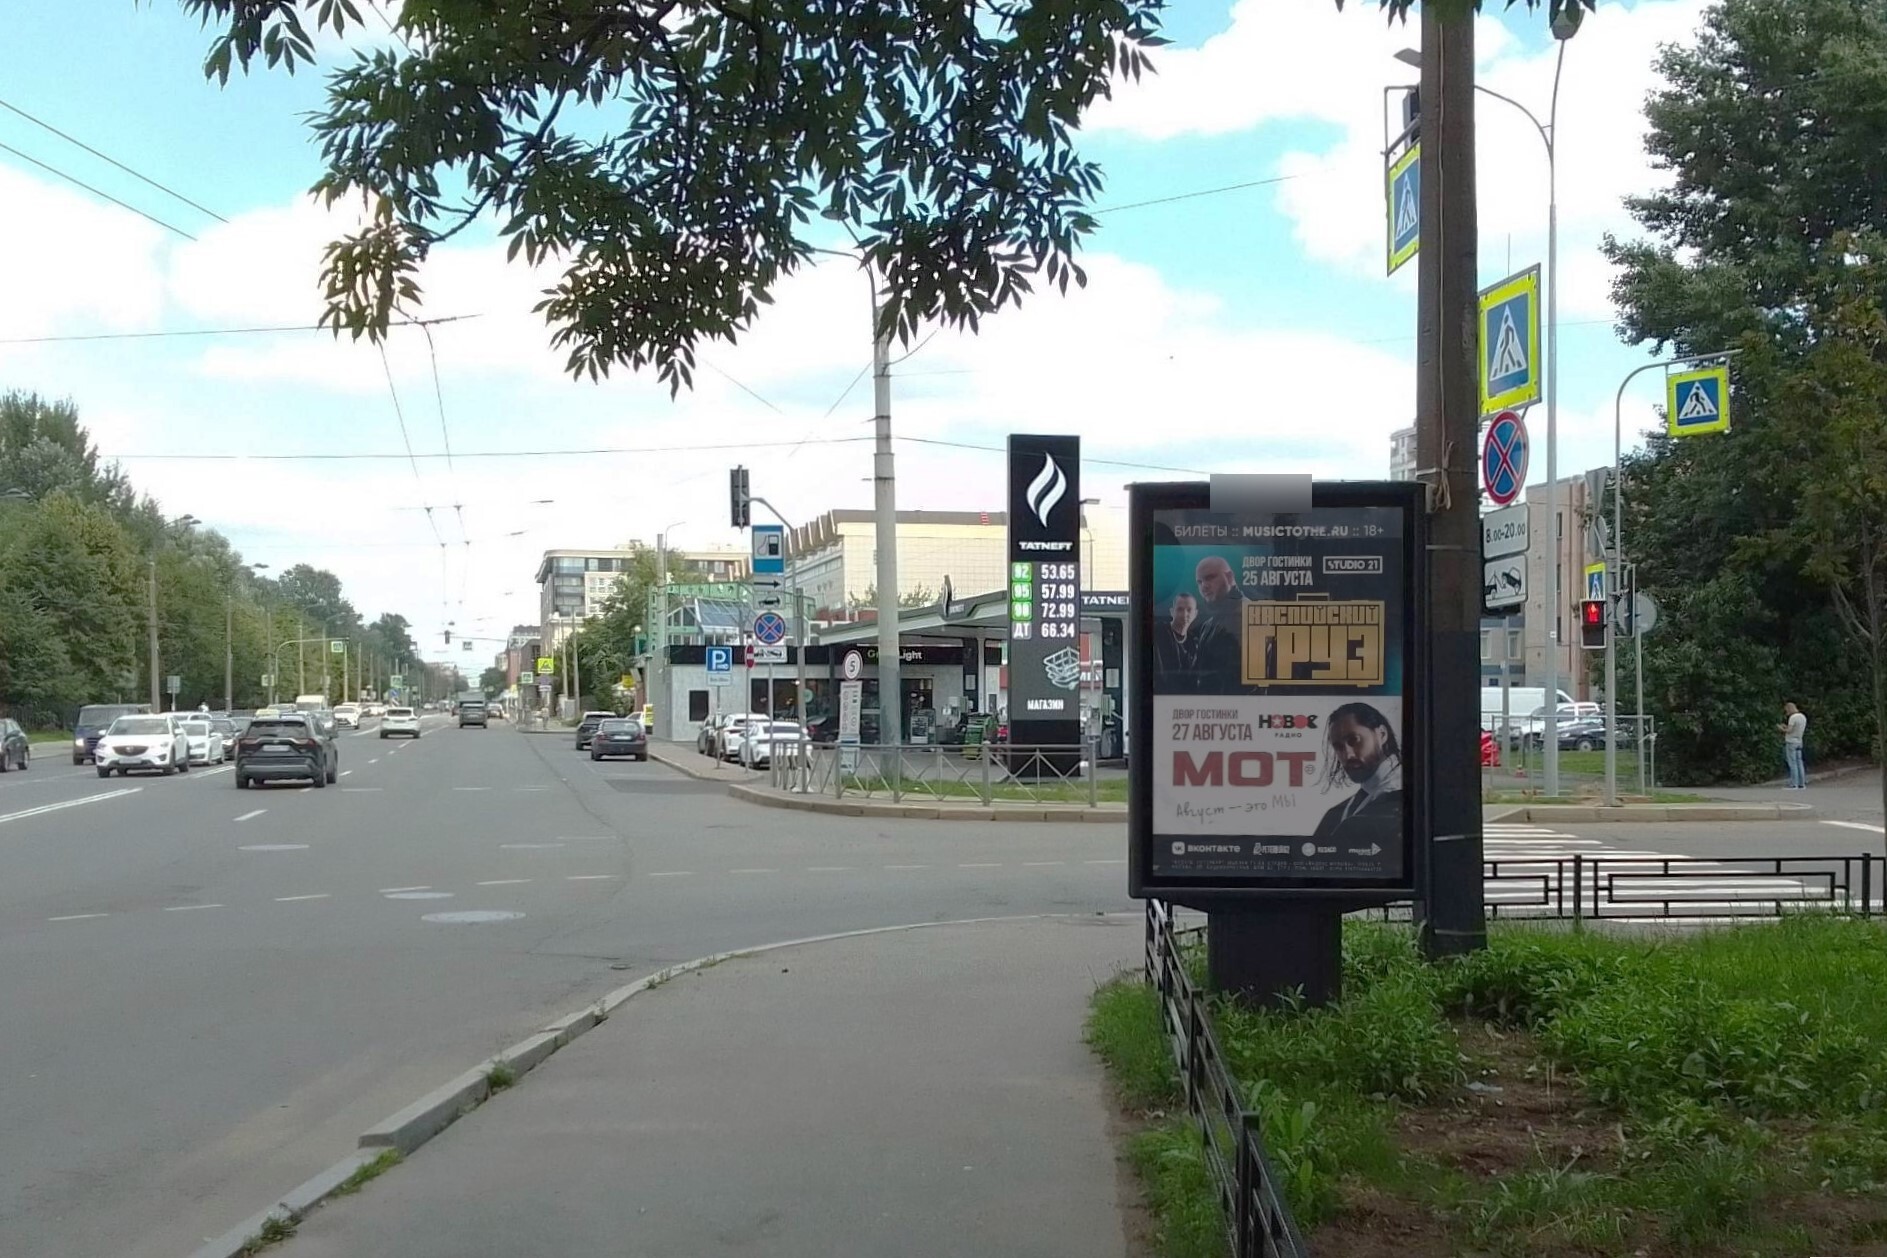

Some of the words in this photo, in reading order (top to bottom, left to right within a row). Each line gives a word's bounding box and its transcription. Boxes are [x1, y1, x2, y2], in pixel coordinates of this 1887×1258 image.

[1174, 525, 1228, 537] БИЛЕТЫ
[1243, 525, 1349, 537] MUSICTOTHE.RU
[1364, 525, 1384, 537] 18+
[1486, 522, 1526, 543] 8.00-20.00
[1018, 541, 1073, 551] TATNEFT
[1242, 555, 1266, 568] ДВОР
[1268, 555, 1312, 568] ГОСТИНКИ
[1328, 560, 1365, 570] STUDIO
[1368, 560, 1379, 570] 21
[1041, 564, 1075, 579] 53.65
[1243, 570, 1258, 586] 25
[1261, 570, 1313, 586] АВГУСТА
[1041, 584, 1075, 599] 57.99
[1041, 603, 1075, 618] 72.99
[1248, 605, 1379, 625] КАСПИЙСКИЙ
[1013, 622, 1029, 638] ДТ
[1041, 622, 1075, 638] 66.34
[1248, 625, 1379, 679] ГРУЗ
[849, 660, 856, 673] 5
[1027, 699, 1064, 711] МАГАЗИН
[1172, 709, 1195, 720] ДВОР
[1196, 709, 1238, 720] ГОСТИНКИ
[1258, 714, 1319, 729] НОВОЕ
[1172, 723, 1190, 741] 27
[1192, 723, 1253, 741] АВГУСТА
[1172, 751, 1316, 787] МОТ
[1176, 801, 1225, 824] Август
[1244, 801, 1268, 813] это
